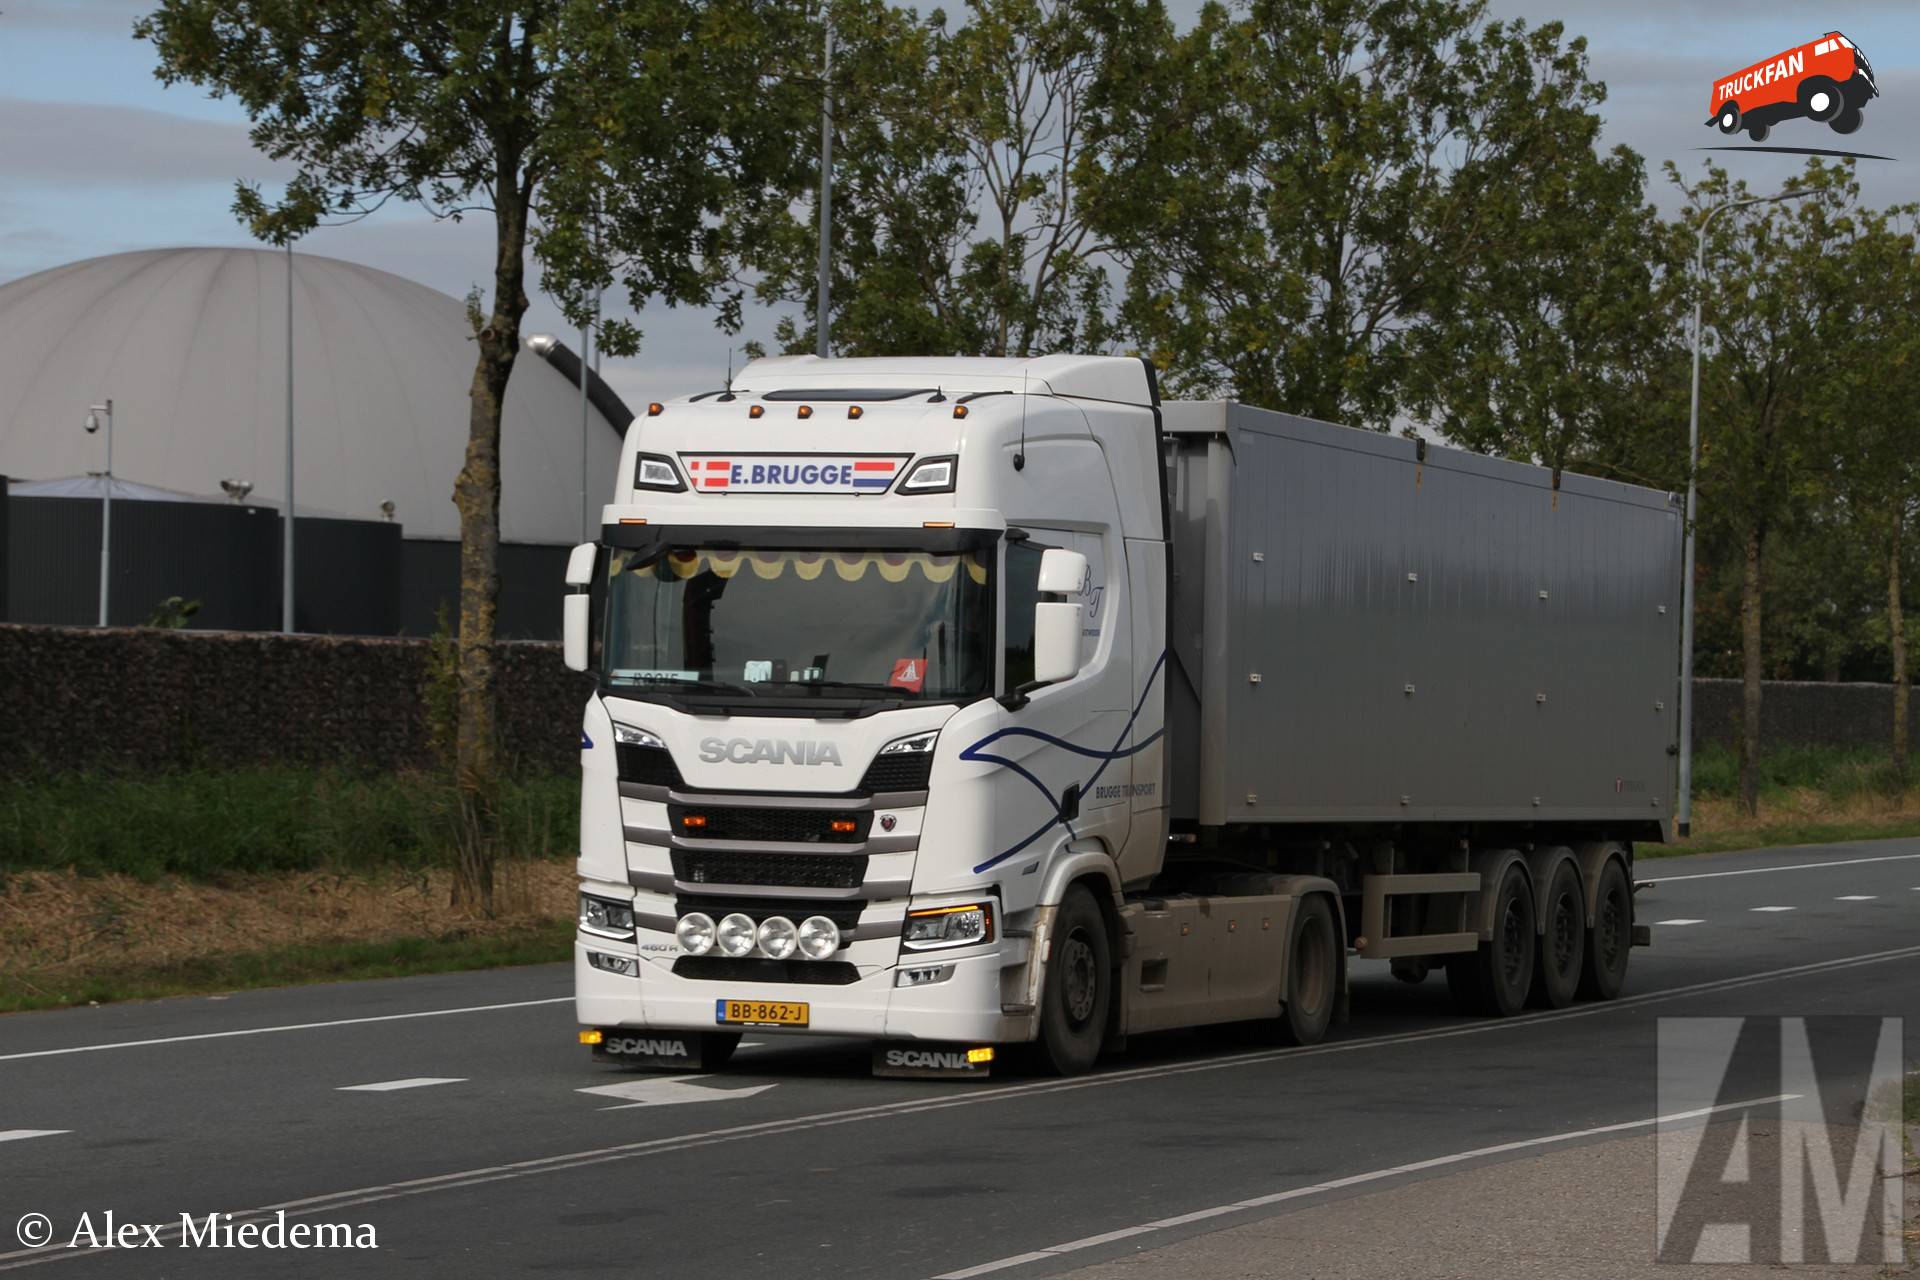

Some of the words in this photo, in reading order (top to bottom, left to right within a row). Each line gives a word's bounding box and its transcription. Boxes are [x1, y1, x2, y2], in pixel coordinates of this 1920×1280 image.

[730, 464, 852, 485] E.BRUGGE
[699, 737, 843, 767] SCANIA
[1096, 785, 1121, 799] BRUGGE
[1122, 783, 1156, 797] TRANSPORT
[732, 1003, 802, 1020] BB-862-J
[607, 1038, 687, 1056] SCANIA
[886, 1050, 975, 1070] SCANIA
